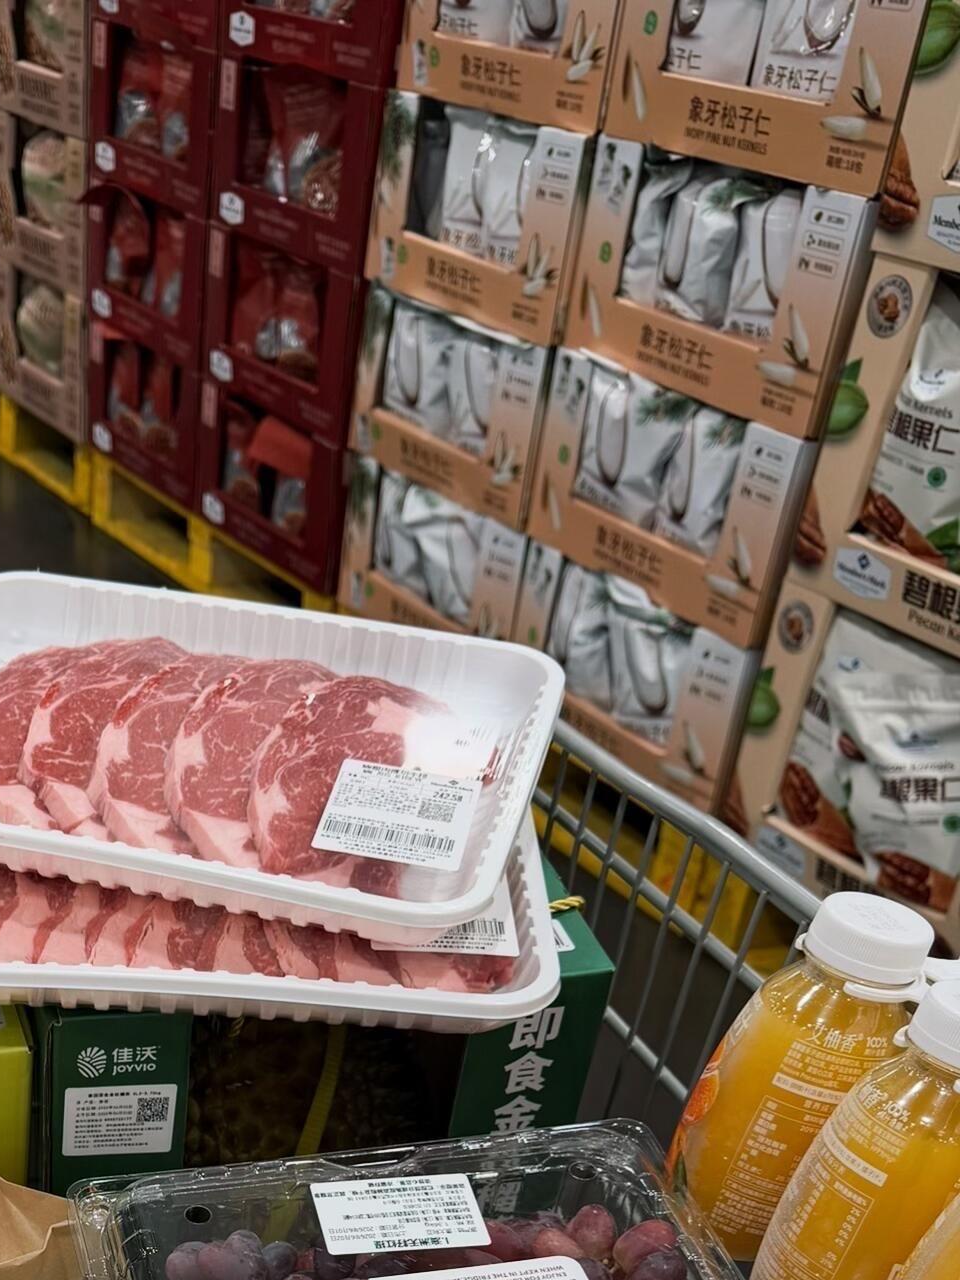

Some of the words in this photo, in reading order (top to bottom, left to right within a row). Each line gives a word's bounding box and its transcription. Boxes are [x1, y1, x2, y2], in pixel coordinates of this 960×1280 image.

[764, 64, 837, 94] 象牙松子仁
[688, 96, 771, 137] 象牙松子仁
[806, 1023, 859, 1054] 艾柚香
[866, 1037, 889, 1049] 100%
[112, 1046, 158, 1063] 佳沃
[112, 1063, 157, 1076] JOYVIO
